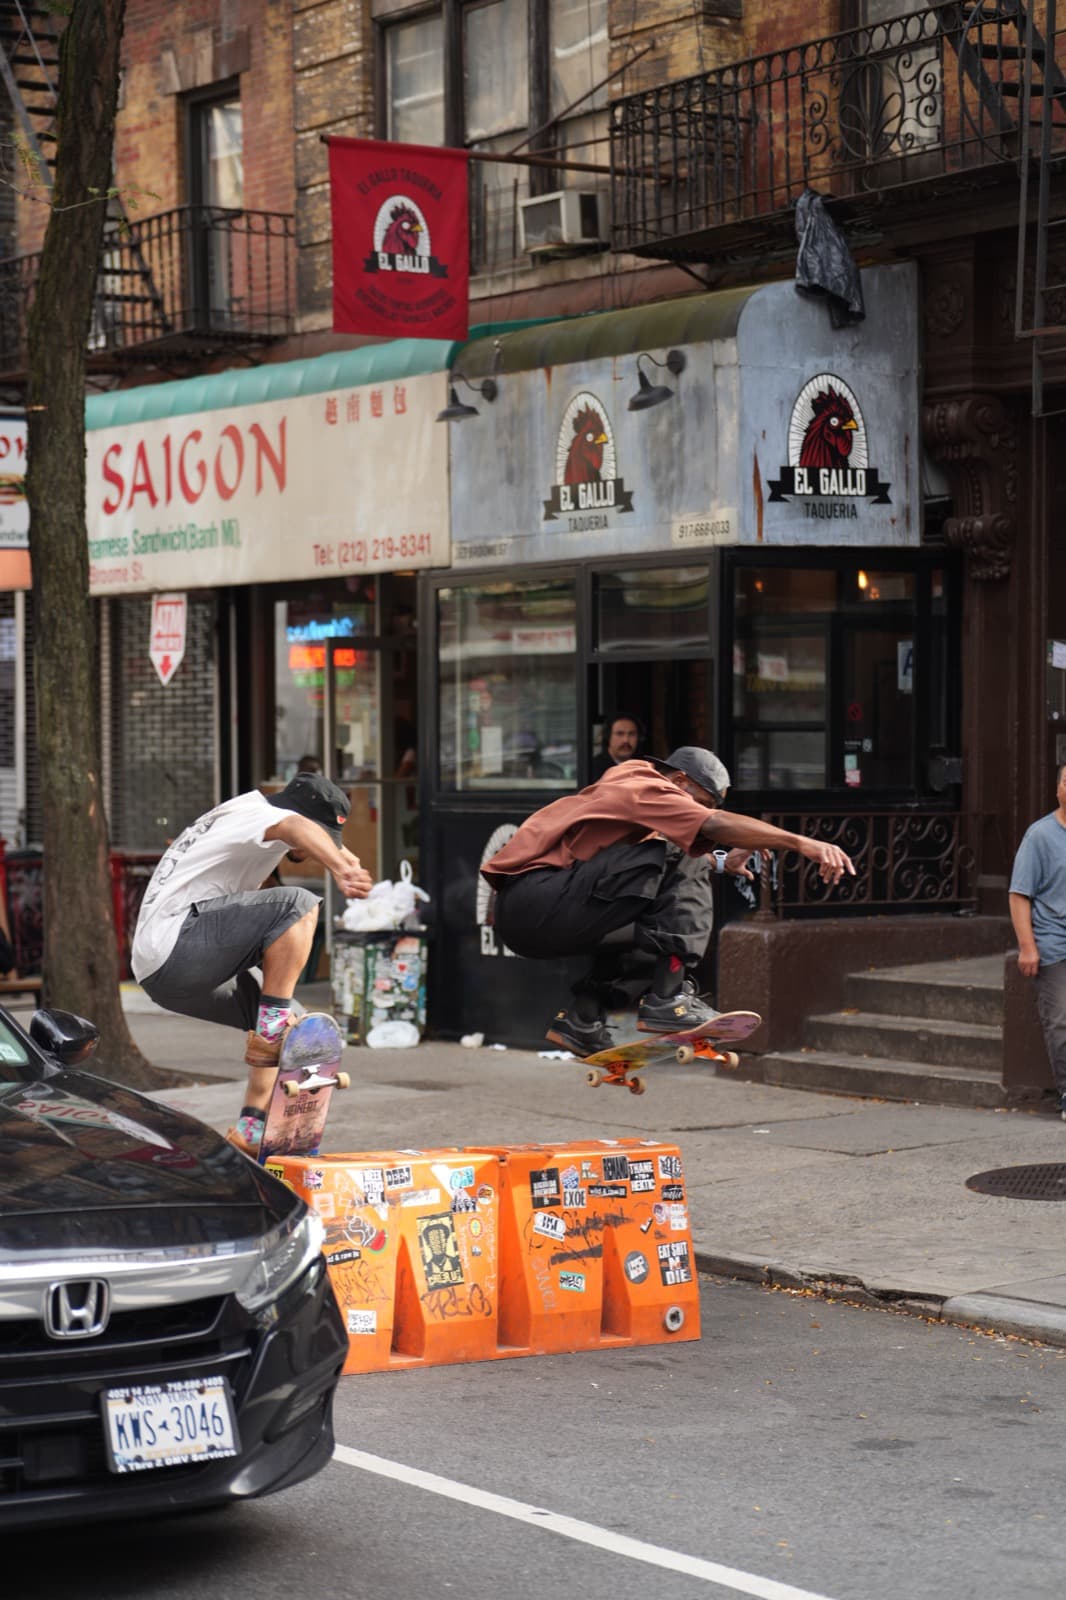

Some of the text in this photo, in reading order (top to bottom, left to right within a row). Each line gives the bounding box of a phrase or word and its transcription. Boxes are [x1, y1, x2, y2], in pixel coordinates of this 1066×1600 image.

[378, 252, 430, 274] EL GALLO
[102, 415, 288, 516] SAIGON
[794, 467, 866, 496] EL GALLO
[560, 480, 615, 511] EL GALLO
[805, 502, 858, 519] TAQUERIA
[568, 514, 608, 532] TAQUERIA
[338, 539, 368, 569] (212)
[372, 533, 431, 561] 219-8341
[665, 1269, 692, 1285] DIE
[136, 1387, 198, 1407] NEW YORK
[170, 1402, 224, 1442] 3046
[165, 1454, 189, 1466] DMV
[191, 1448, 238, 1462] Services
